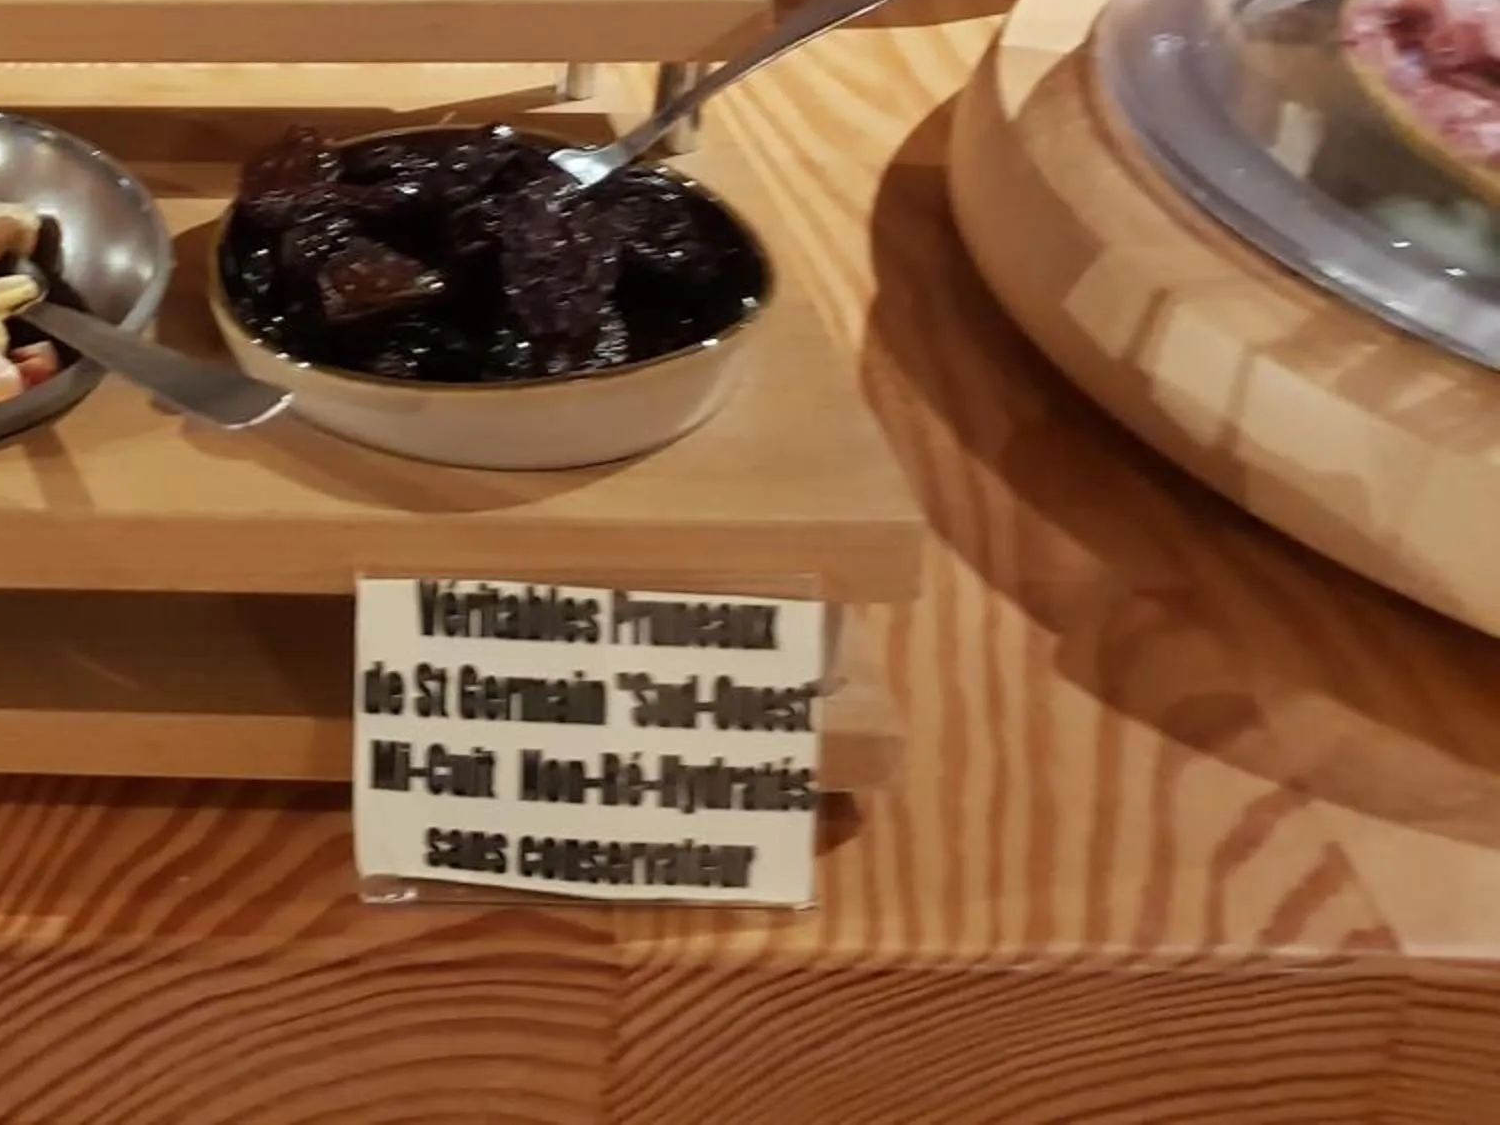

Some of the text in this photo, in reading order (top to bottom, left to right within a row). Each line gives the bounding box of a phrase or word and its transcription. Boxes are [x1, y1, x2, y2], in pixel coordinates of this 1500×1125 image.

[364, 661, 405, 716] de
[414, 662, 449, 718] St
[459, 664, 607, 726] Germain
[425, 827, 756, 889] sans conservateur
